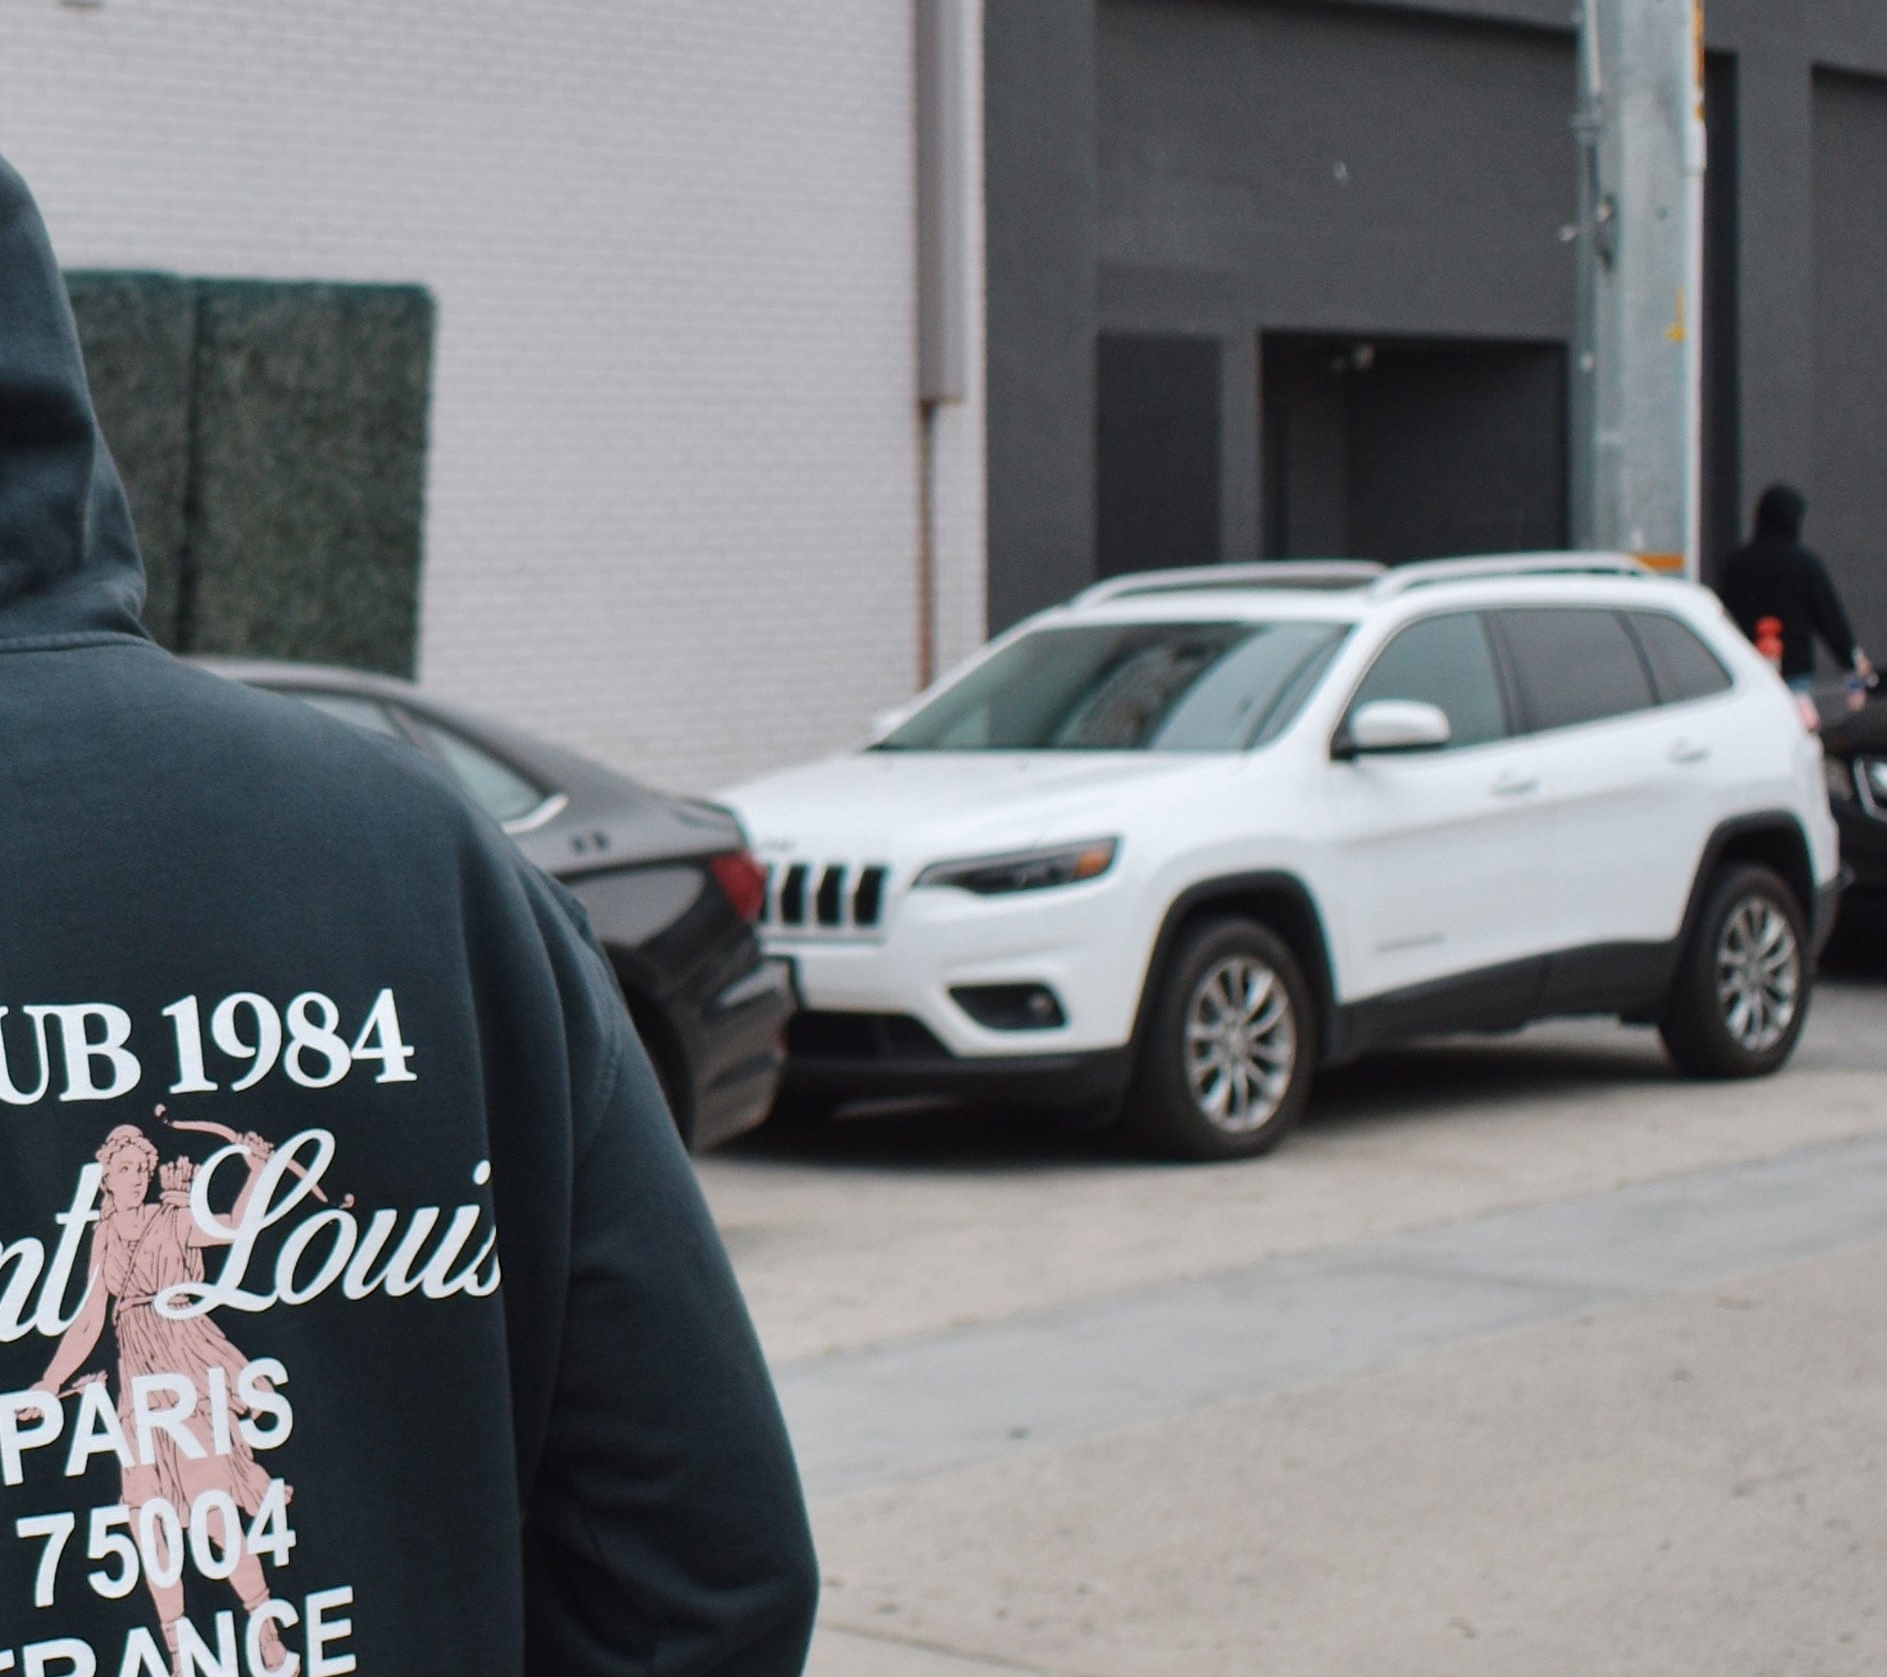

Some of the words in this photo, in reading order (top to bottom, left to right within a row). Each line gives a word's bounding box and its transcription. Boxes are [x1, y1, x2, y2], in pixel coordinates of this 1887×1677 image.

[162, 988, 418, 1095] 1984
[154, 1128, 502, 1321] Louis
[16, 1478, 297, 1608] 75004
